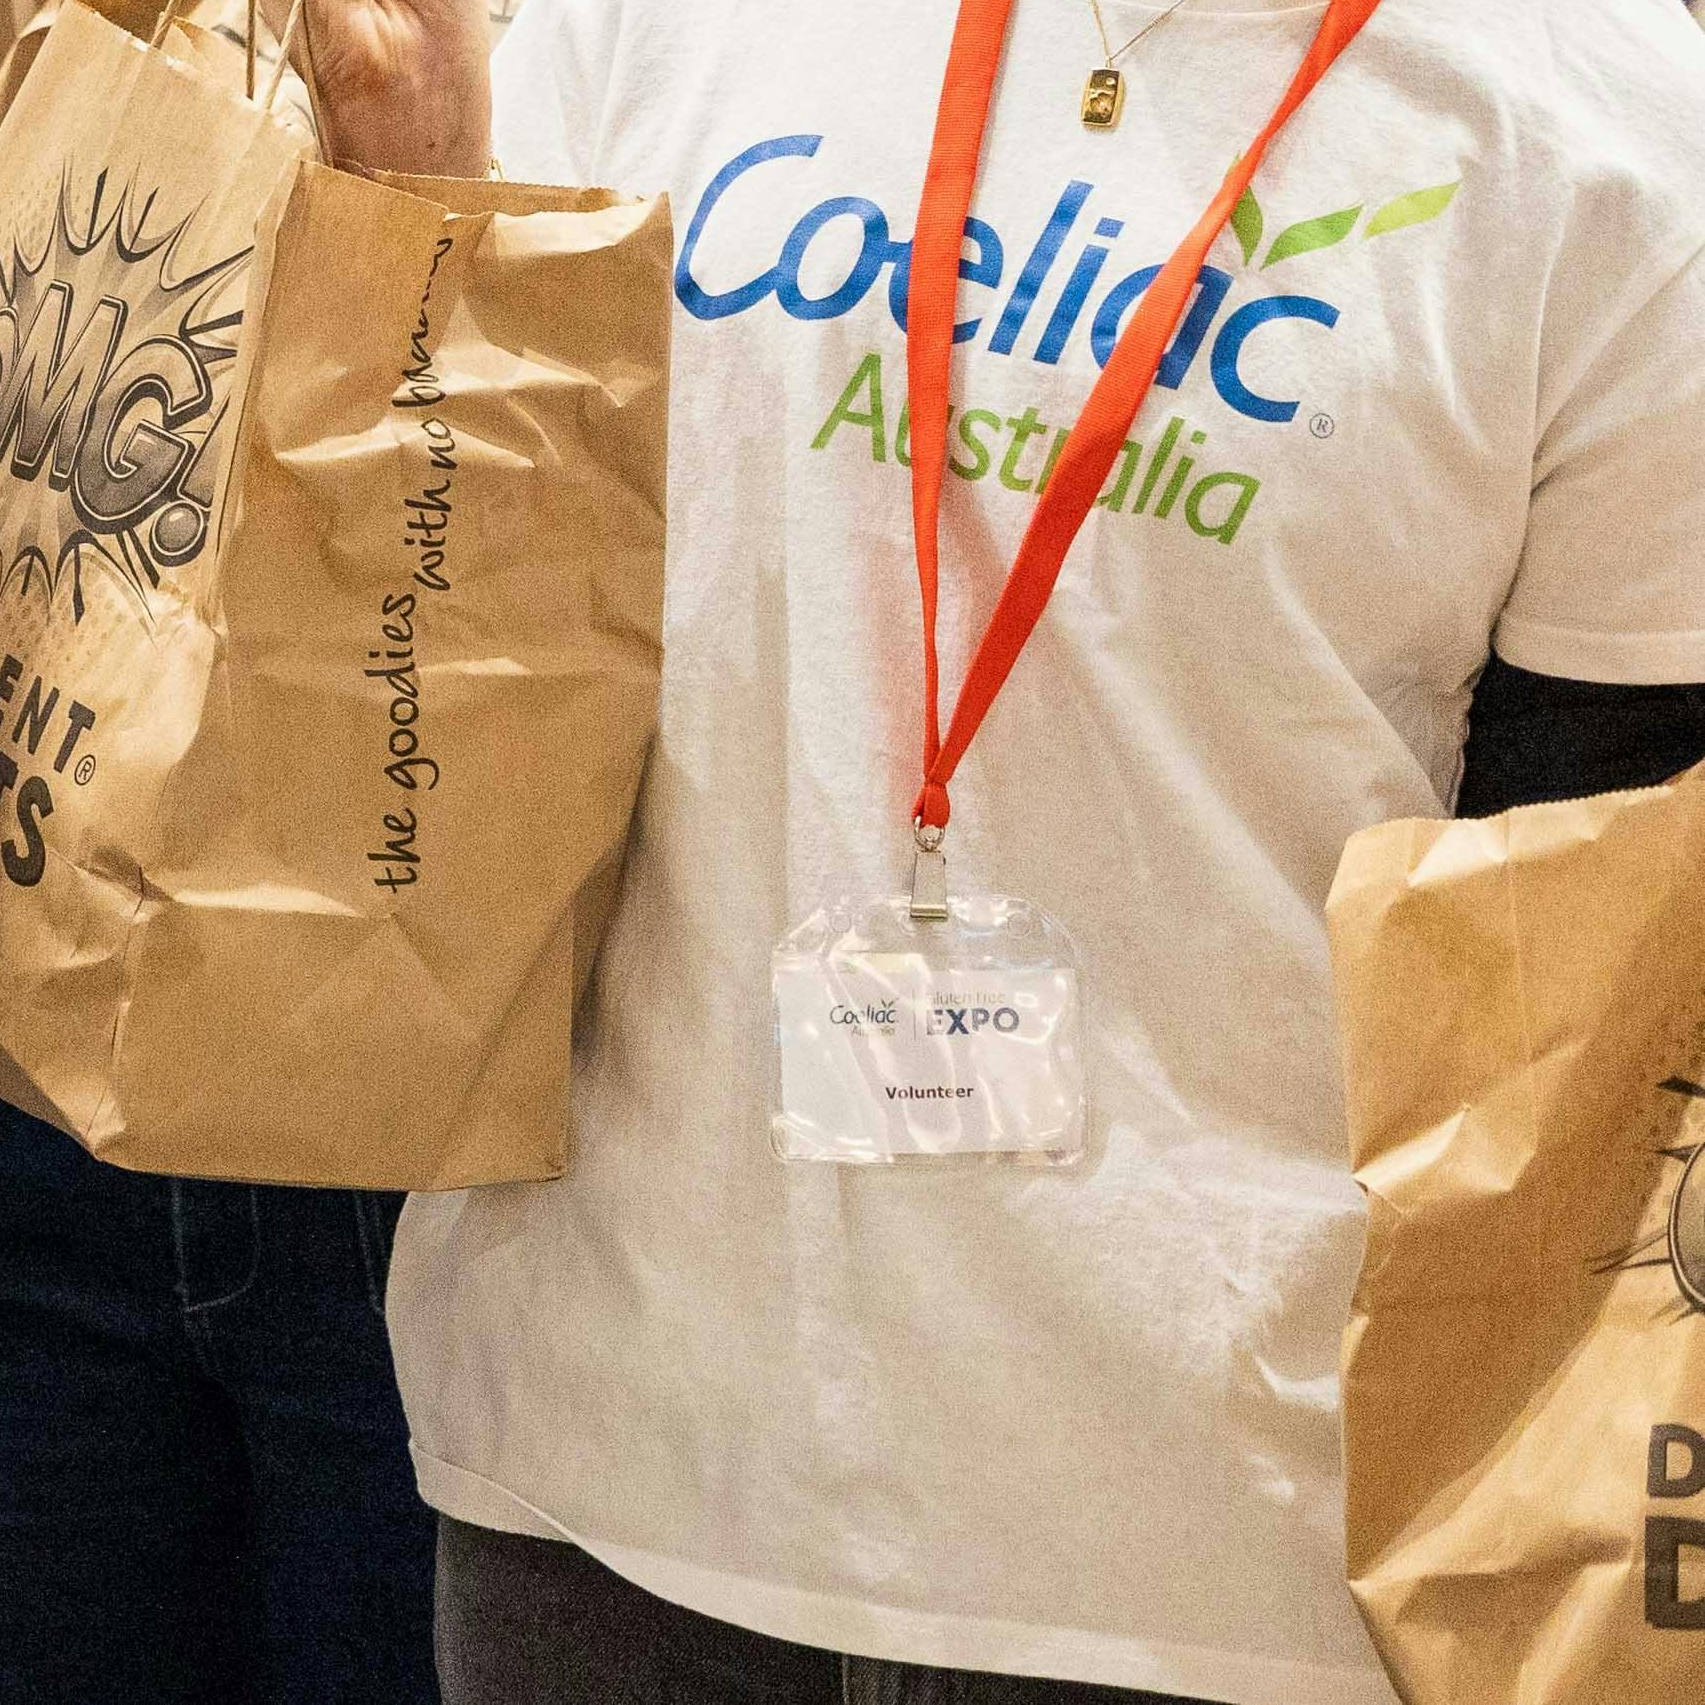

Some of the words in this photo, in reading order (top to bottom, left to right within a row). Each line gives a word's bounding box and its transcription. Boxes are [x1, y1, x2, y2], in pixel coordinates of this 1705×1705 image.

[421, 417, 459, 471] no
[404, 479, 453, 592] with
[364, 593, 440, 791] goodies
[366, 807, 421, 894] the
[925, 1006, 1020, 1036] EXPO
[885, 1085, 975, 1100] Volunteer
